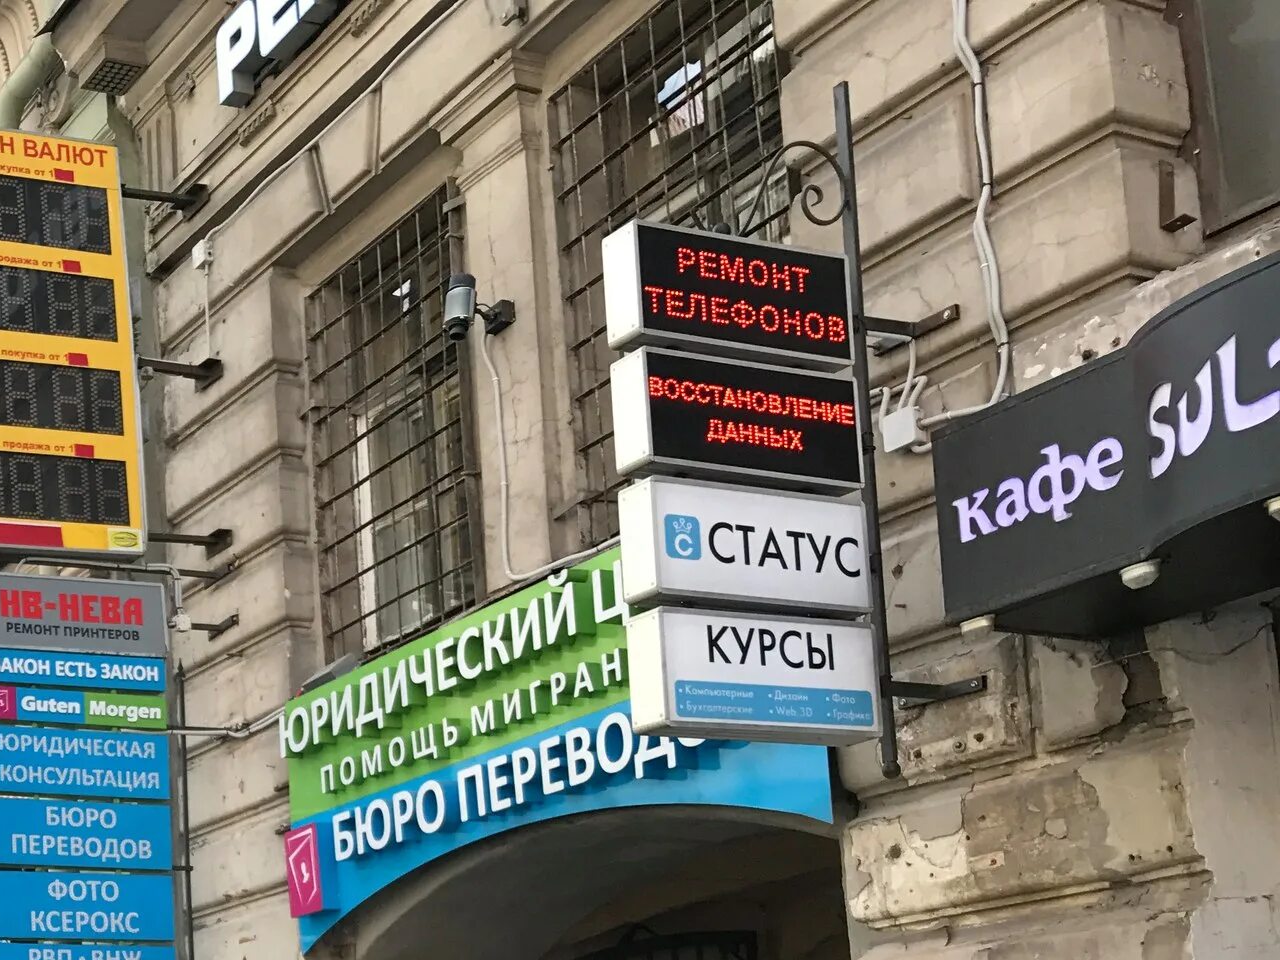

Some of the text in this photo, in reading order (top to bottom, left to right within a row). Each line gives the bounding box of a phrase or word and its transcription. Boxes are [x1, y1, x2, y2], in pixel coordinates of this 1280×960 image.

[215, 0, 316, 105] РЕ
[23, 139, 108, 167] ВАЛЮТ
[42, 260, 53, 268] от
[677, 247, 811, 293] РЕМОНТ
[644, 286, 846, 342] ТЕЛЕФОНОВ
[1, 349, 45, 360] покупка
[648, 376, 855, 425] ВОССТАНОВЛЕНИЕ
[2, 440, 51, 451] продажа
[707, 418, 804, 451] ДАННЫХ
[952, 334, 1280, 543] кафе SUL
[708, 521, 862, 578] СТАТУС
[0, 589, 144, 626] НВ-НЕВА
[6, 622, 140, 641] РЕМОНТ ПРИНТЕРОВ
[706, 624, 835, 671] КУРСЫ
[55, 660, 96, 679] ЕСТЬ
[101, 664, 159, 682] ЗАКОН
[279, 569, 577, 759] ЮРИДИЧЕСКИЙ
[21, 696, 161, 721] Guten Morgen
[320, 648, 622, 794] ПОМОЩЬ МИГРАН
[0, 733, 156, 759] ЮРИДИЧЕСКАЯ
[0, 764, 160, 792] КОНСУЛЬТАЦИЯ
[332, 712, 705, 862] БЮРО ПЕРЕВОД
[46, 806, 117, 829] БЮРО
[12, 834, 153, 862] ПЕРЕВОДОВ
[48, 879, 120, 902] ФОТО
[30, 911, 140, 934] КСЕРОКС
